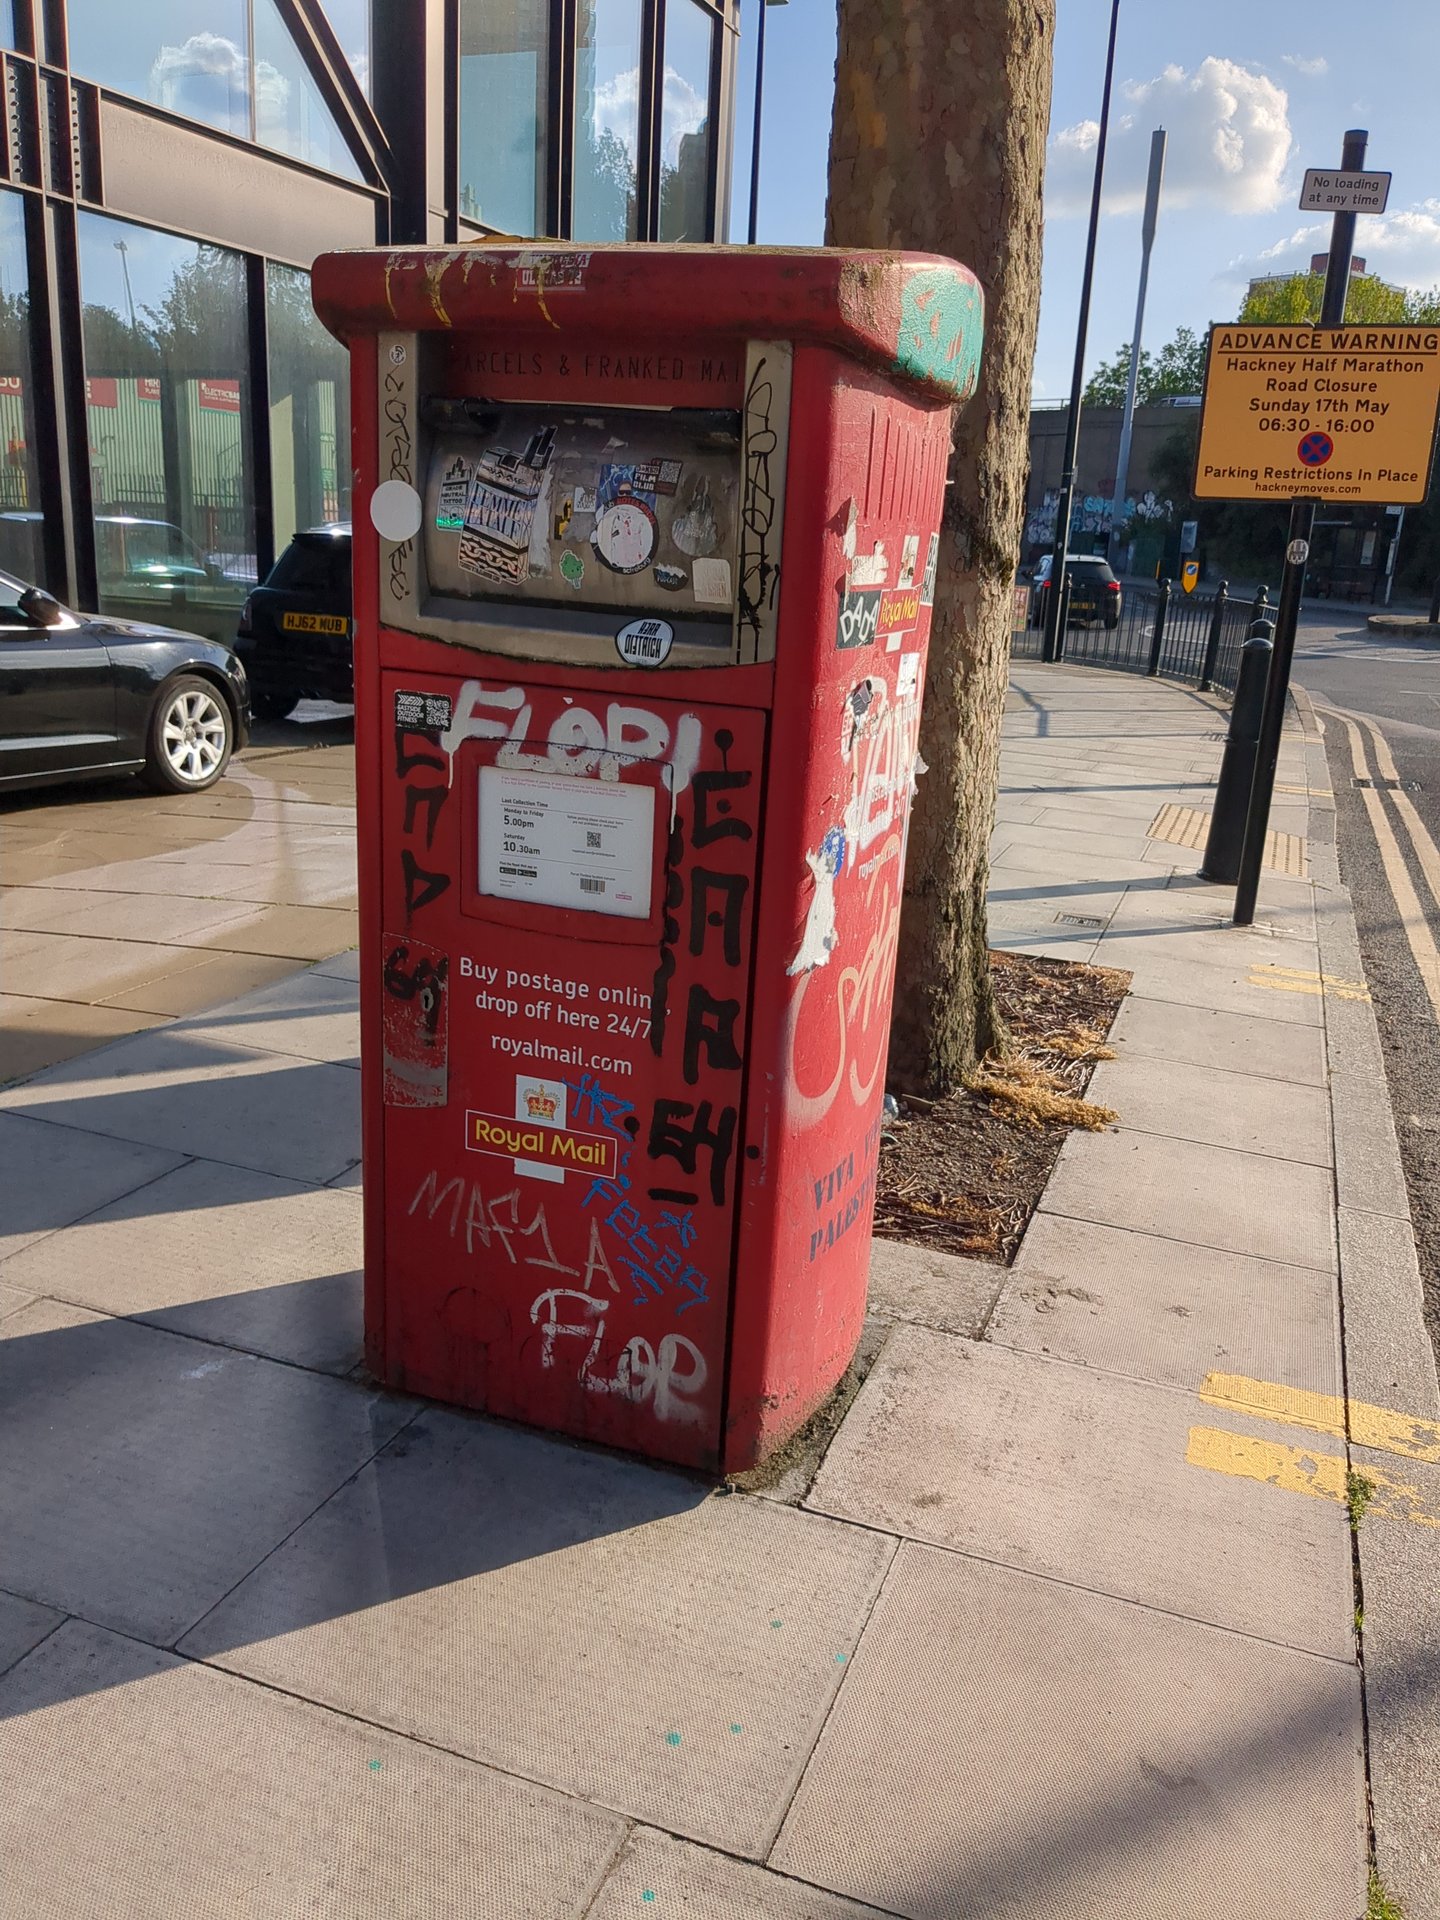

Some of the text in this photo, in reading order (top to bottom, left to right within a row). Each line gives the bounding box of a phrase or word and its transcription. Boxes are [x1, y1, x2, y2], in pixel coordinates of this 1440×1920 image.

[1313, 177, 1379, 191] No loading
[1308, 192, 1379, 205] at any time
[1220, 333, 1438, 350] ADVANCE WARNING
[463, 350, 740, 384] ARCELS & FRANKED MAI
[1226, 358, 1424, 374] Hackney Half Marathon
[1266, 378, 1377, 392] Road Closure
[1249, 398, 1390, 416] Sunday 17th May
[1259, 418, 1310, 432] 06:30
[1326, 419, 1375, 433] 16:00
[634, 472, 656, 483] FILM
[1204, 466, 1418, 482] Parking Restrictions In Place
[632, 480, 655, 491] CLUB
[1255, 482, 1361, 494] hackneymoves.com
[840, 595, 880, 643] DADA
[397, 710, 425, 718] OUTDOOR
[397, 715, 418, 724] FITNESS
[513, 798, 536, 806] Collection
[504, 807, 522, 815] Monday
[503, 814, 535, 828] 5.00pm
[503, 832, 525, 840] Saturday
[503, 841, 541, 855] 10.30am
[459, 956, 498, 984] Buy
[506, 971, 590, 1000] postage
[475, 991, 652, 1040] drop off here 24/7
[491, 1032, 633, 1077] royalmail.com
[474, 1118, 607, 1166] Royal Mail
